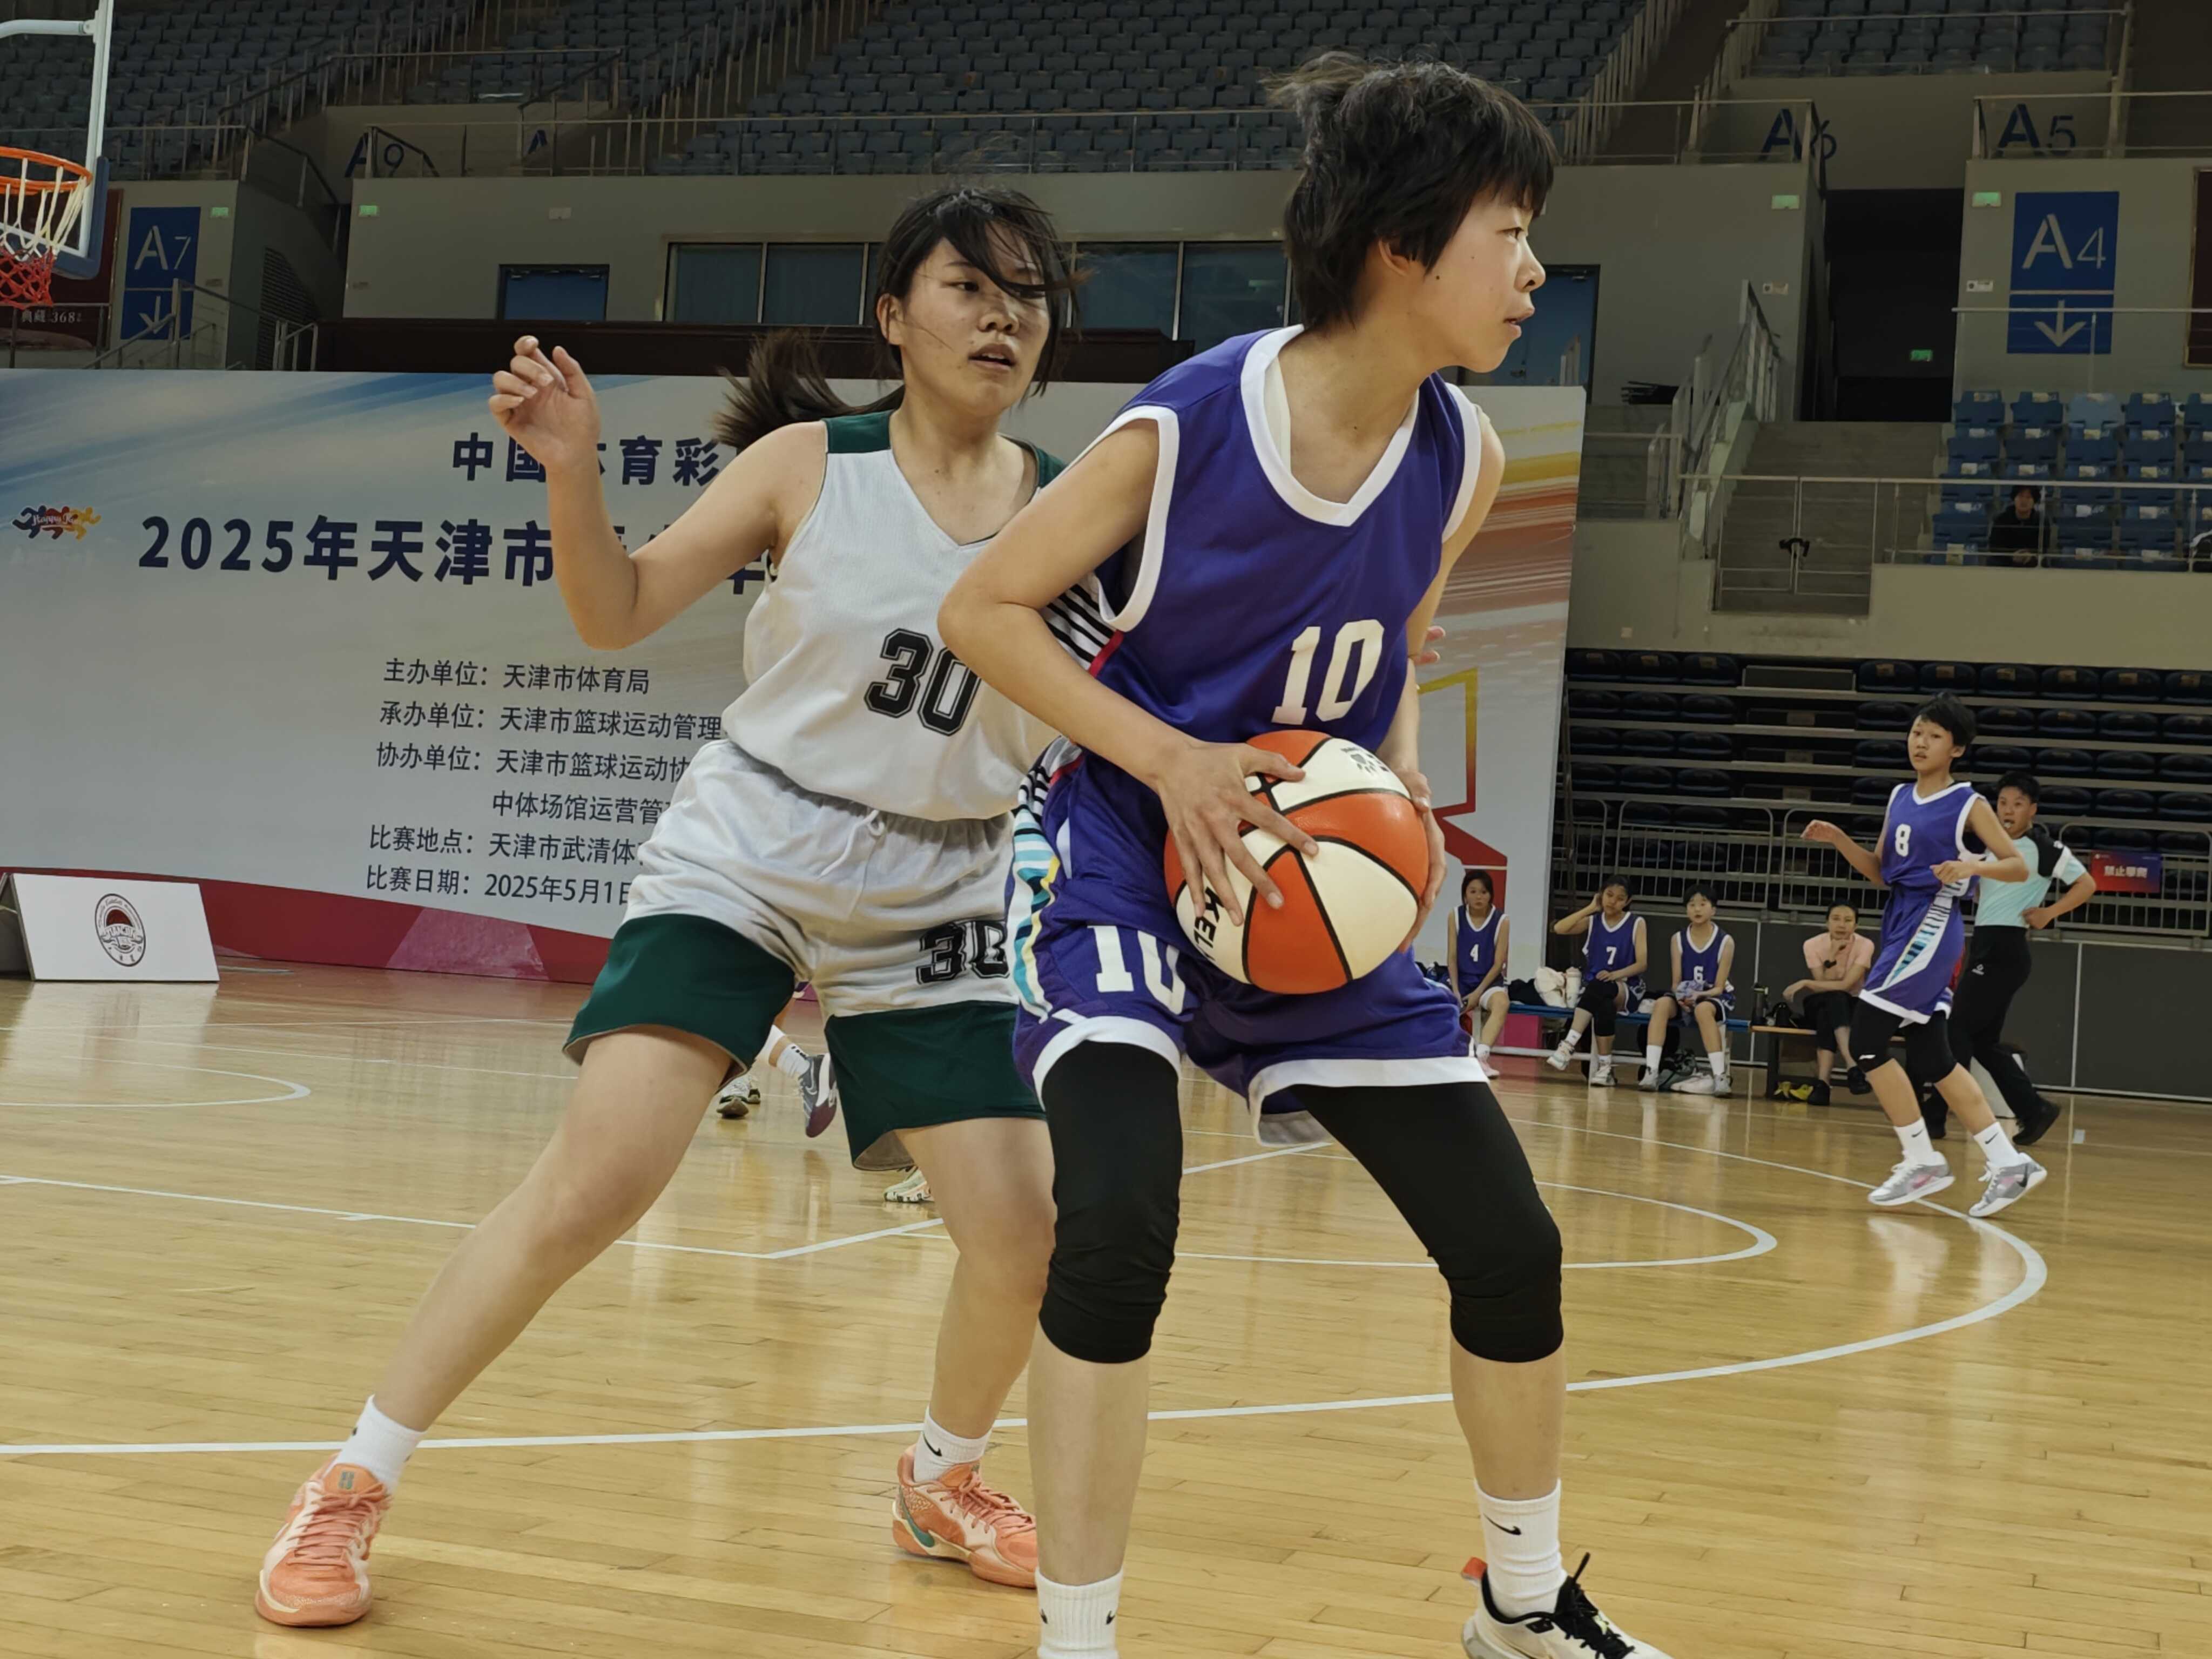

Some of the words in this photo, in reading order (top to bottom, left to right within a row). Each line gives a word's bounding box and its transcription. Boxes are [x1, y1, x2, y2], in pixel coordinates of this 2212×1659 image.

[1996, 103, 2076, 157] A5
[134, 225, 191, 270] A7
[2021, 213, 2106, 269] A4
[453, 432, 719, 486] 中国育彩
[383, 657, 487, 686] 主办单位：
[503, 664, 650, 694] 天津市体育局
[864, 628, 982, 737] 30
[1271, 619, 1385, 725] 10
[380, 700, 483, 729] 承办单位：
[500, 706, 721, 740] 天津市篮球运动管理
[376, 741, 480, 771] 协办单位：
[493, 790, 671, 825] 中体场馆运营管
[370, 824, 473, 854] 比赛地点：
[488, 832, 644, 866] 天津市武清体
[1894, 823, 1912, 858] 8
[366, 864, 469, 895] 比赛日期：
[1193, 886, 1224, 961] KEL
[1469, 943, 1479, 962] 4
[1606, 946, 1617, 965] 7
[1694, 965, 1704, 984] 6
